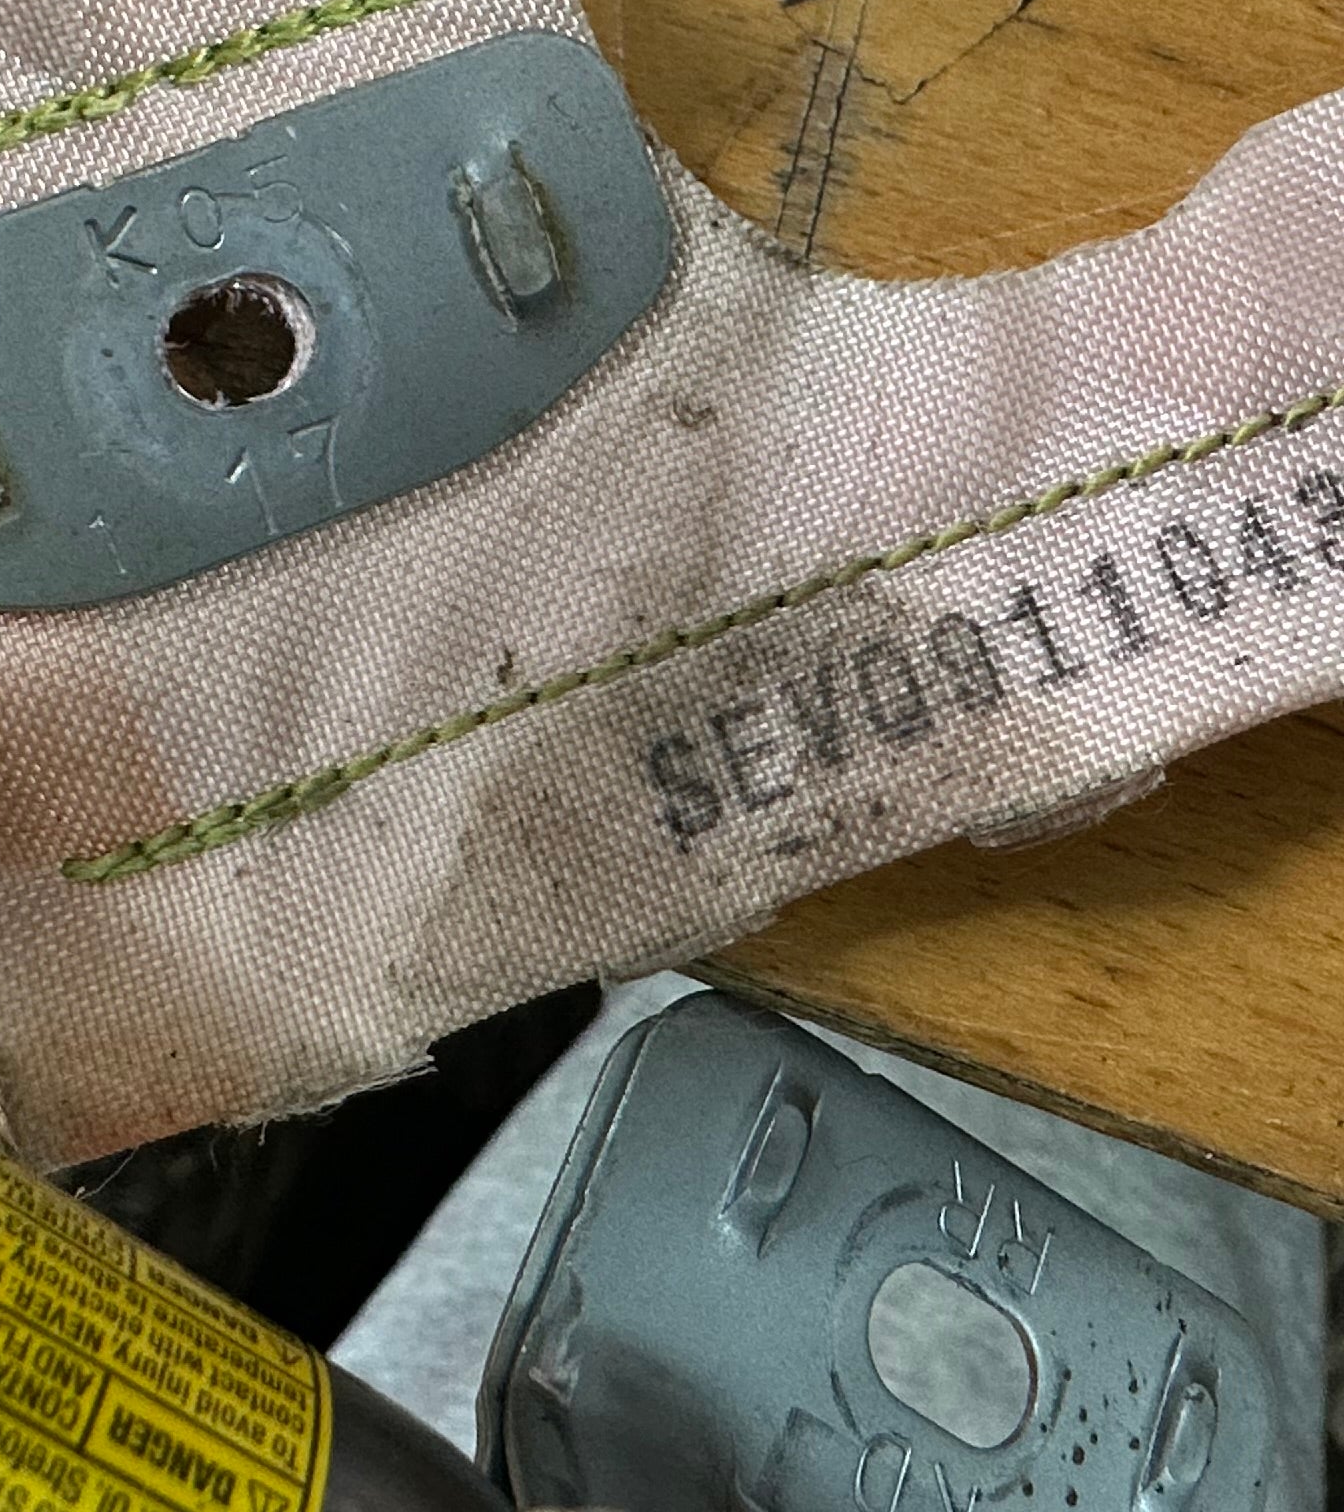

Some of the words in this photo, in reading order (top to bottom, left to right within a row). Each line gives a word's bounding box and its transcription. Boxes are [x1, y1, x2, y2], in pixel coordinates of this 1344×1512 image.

[939, 1159, 1056, 1296] RR
[1, 1277, 107, 1350] NEVER:
[6, 1244, 147, 1338] electricity
[30, 1343, 95, 1395] AND
[102, 1334, 197, 1404] injury,
[144, 1328, 206, 1374] with
[147, 1304, 312, 1408] temperature
[191, 1389, 270, 1447] avoid
[206, 1365, 309, 1435] contact
[103, 1406, 242, 1504] DANGER
[267, 1434, 304, 1468] To
